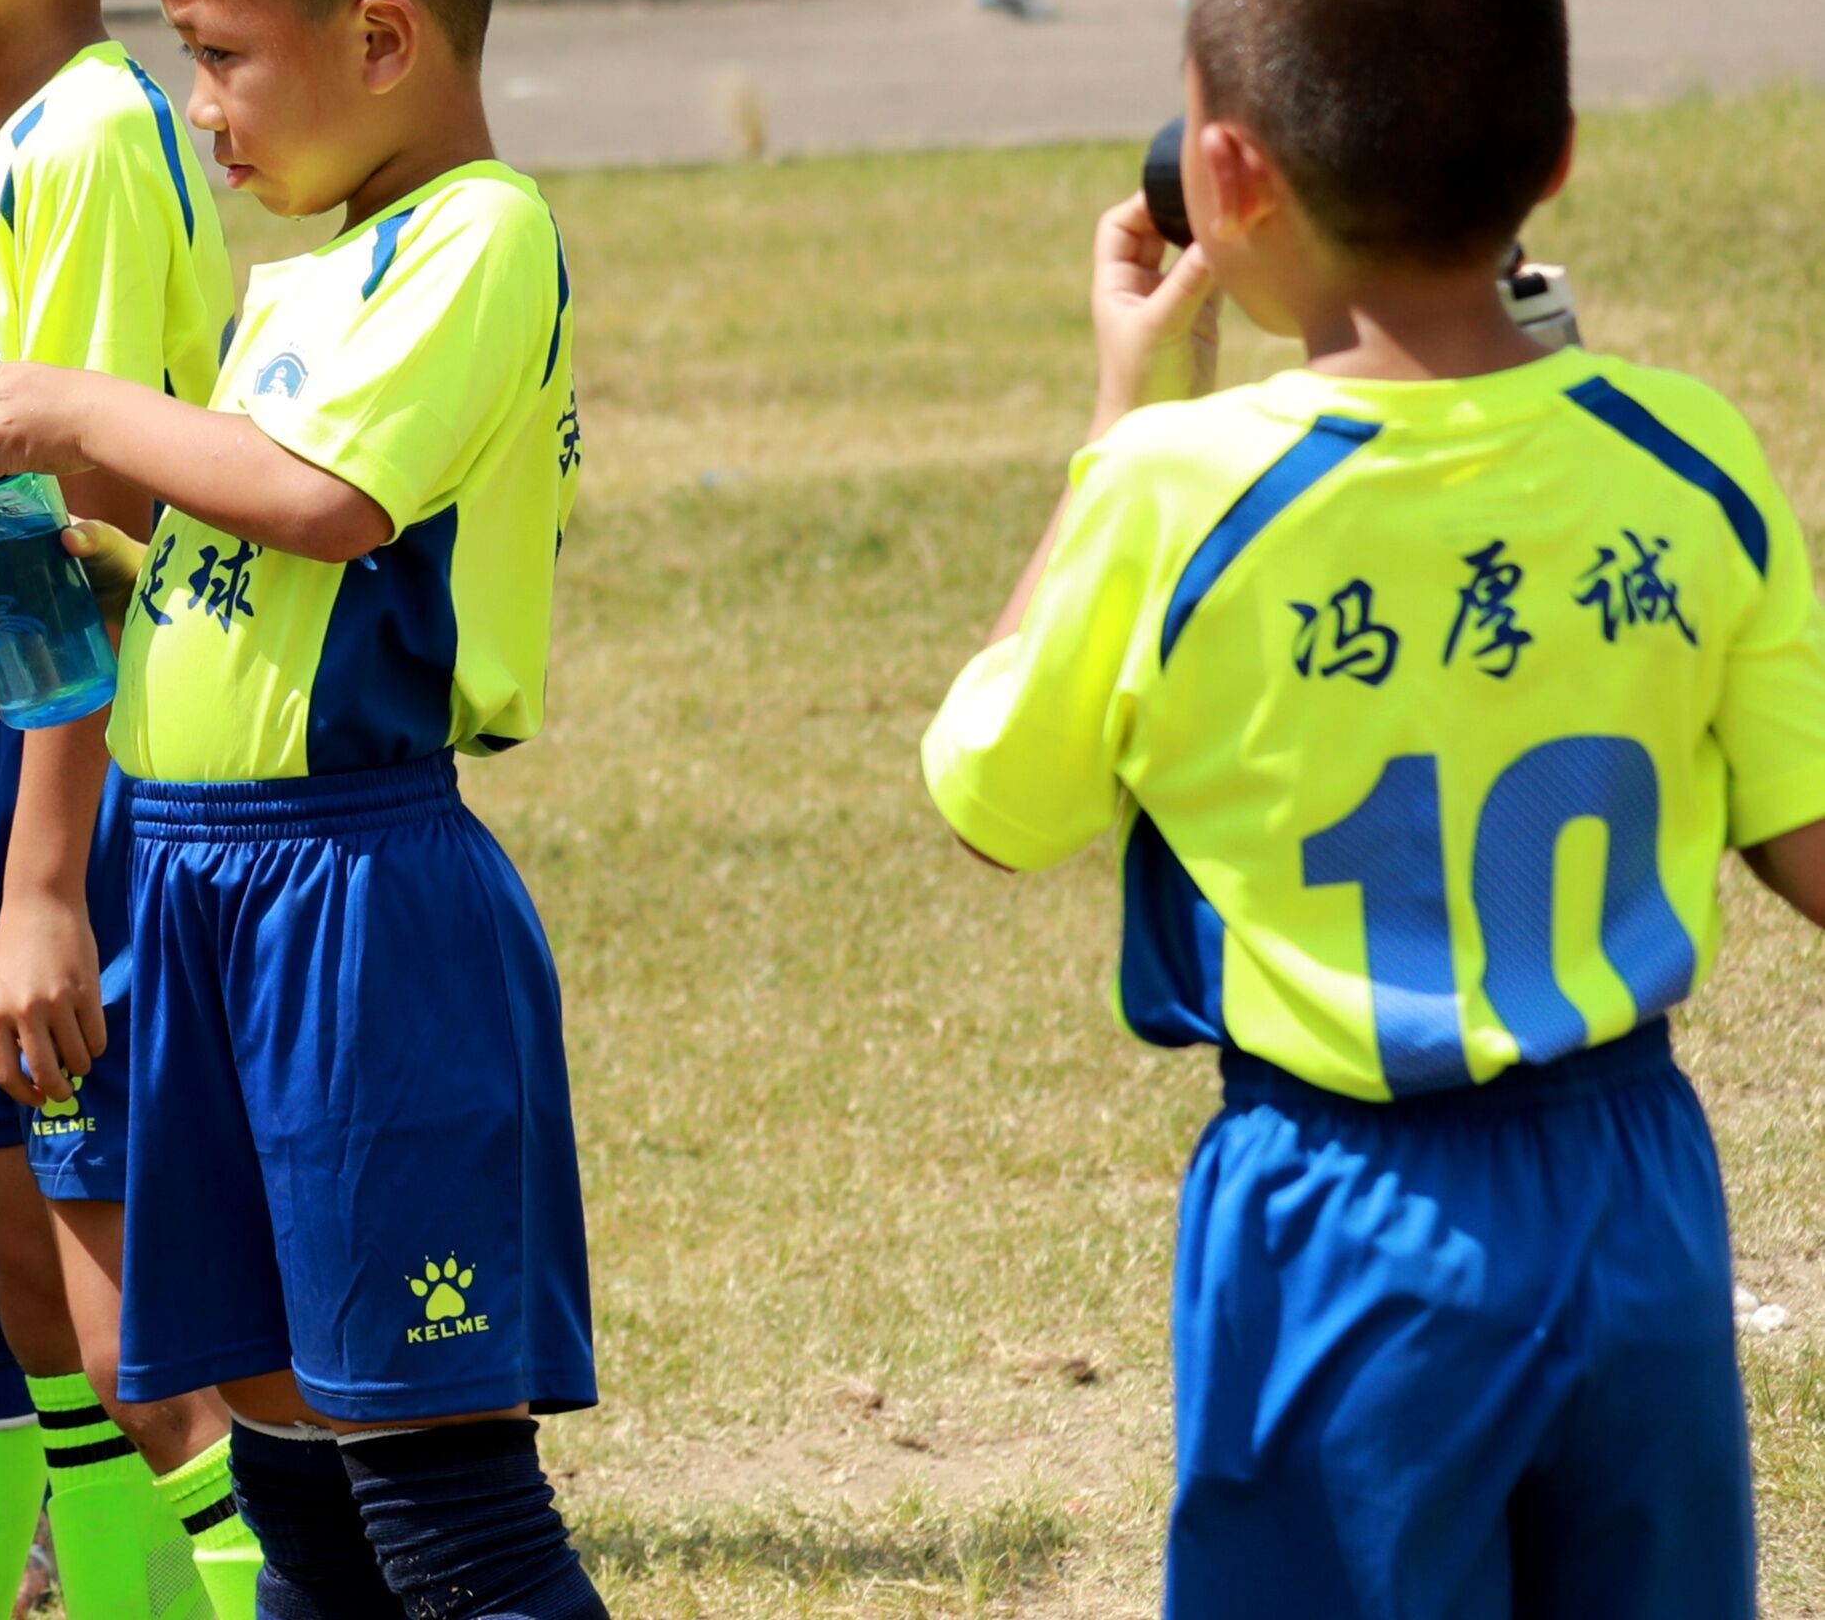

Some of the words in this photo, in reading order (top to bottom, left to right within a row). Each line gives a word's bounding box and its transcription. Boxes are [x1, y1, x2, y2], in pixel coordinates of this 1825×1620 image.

[1288, 529, 1699, 687] 冯厚诚
[1302, 735, 1696, 1098] 10
[31, 1117, 96, 1136] KELME
[407, 1315, 489, 1344] KELME
